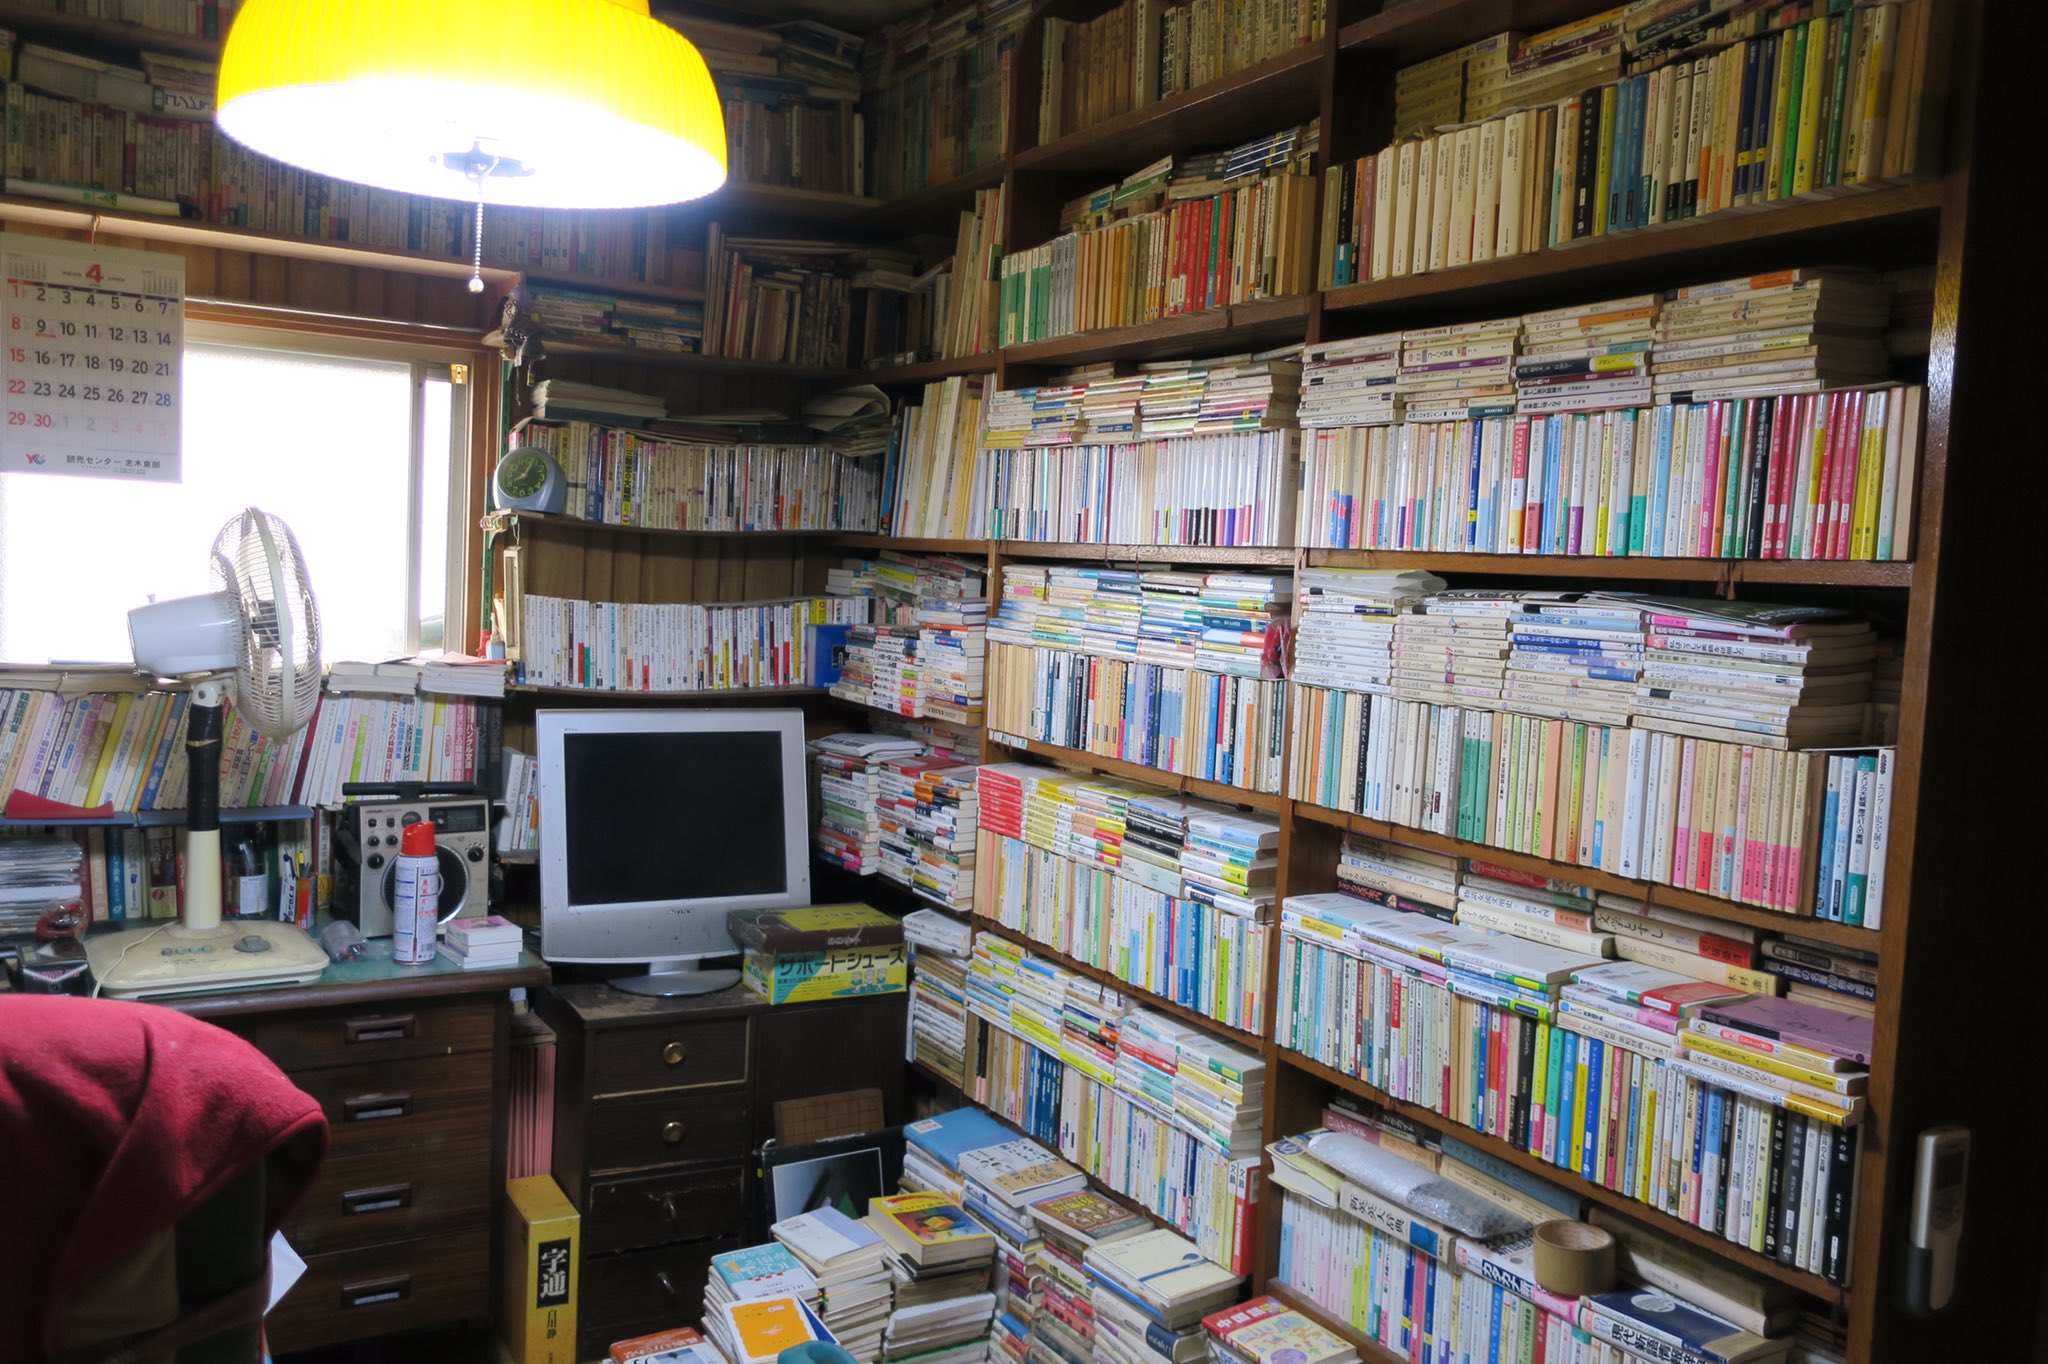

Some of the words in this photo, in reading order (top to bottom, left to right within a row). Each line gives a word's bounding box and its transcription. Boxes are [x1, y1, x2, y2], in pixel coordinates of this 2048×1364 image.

[85, 264, 104, 283] 4
[12, 285, 19, 298] 1
[37, 288, 46, 301] 2
[62, 291, 71, 304] 3
[86, 294, 96, 307] 4
[111, 297, 120, 310] 5
[135, 300, 144, 313] 6
[159, 302, 168, 315] 7
[12, 316, 21, 330] 8
[37, 320, 46, 333] 9
[60, 322, 76, 336] 10
[85, 325, 97, 338] 11
[109, 328, 123, 341] 12
[133, 330, 148, 344] 13
[157, 333, 171, 345] 14
[10, 349, 25, 362] 15
[35, 351, 50, 365] 16
[60, 354, 75, 367] 17
[85, 356, 99, 370] 18
[109, 359, 124, 372] 19
[132, 361, 148, 374] 20
[155, 363, 170, 376] 21
[8, 380, 26, 394] 22
[33, 383, 51, 396] 23
[59, 385, 76, 398] 24
[84, 387, 100, 400] 25
[108, 390, 124, 403] 26
[131, 392, 148, 404] 27
[155, 394, 171, 407] 28
[8, 412, 26, 425] 29
[33, 414, 52, 427] 30
[780, 946, 905, 976] サポートシューズ
[1350, 1195, 1405, 1233] 新英英大辞典
[540, 1247, 568, 1299] 字通
